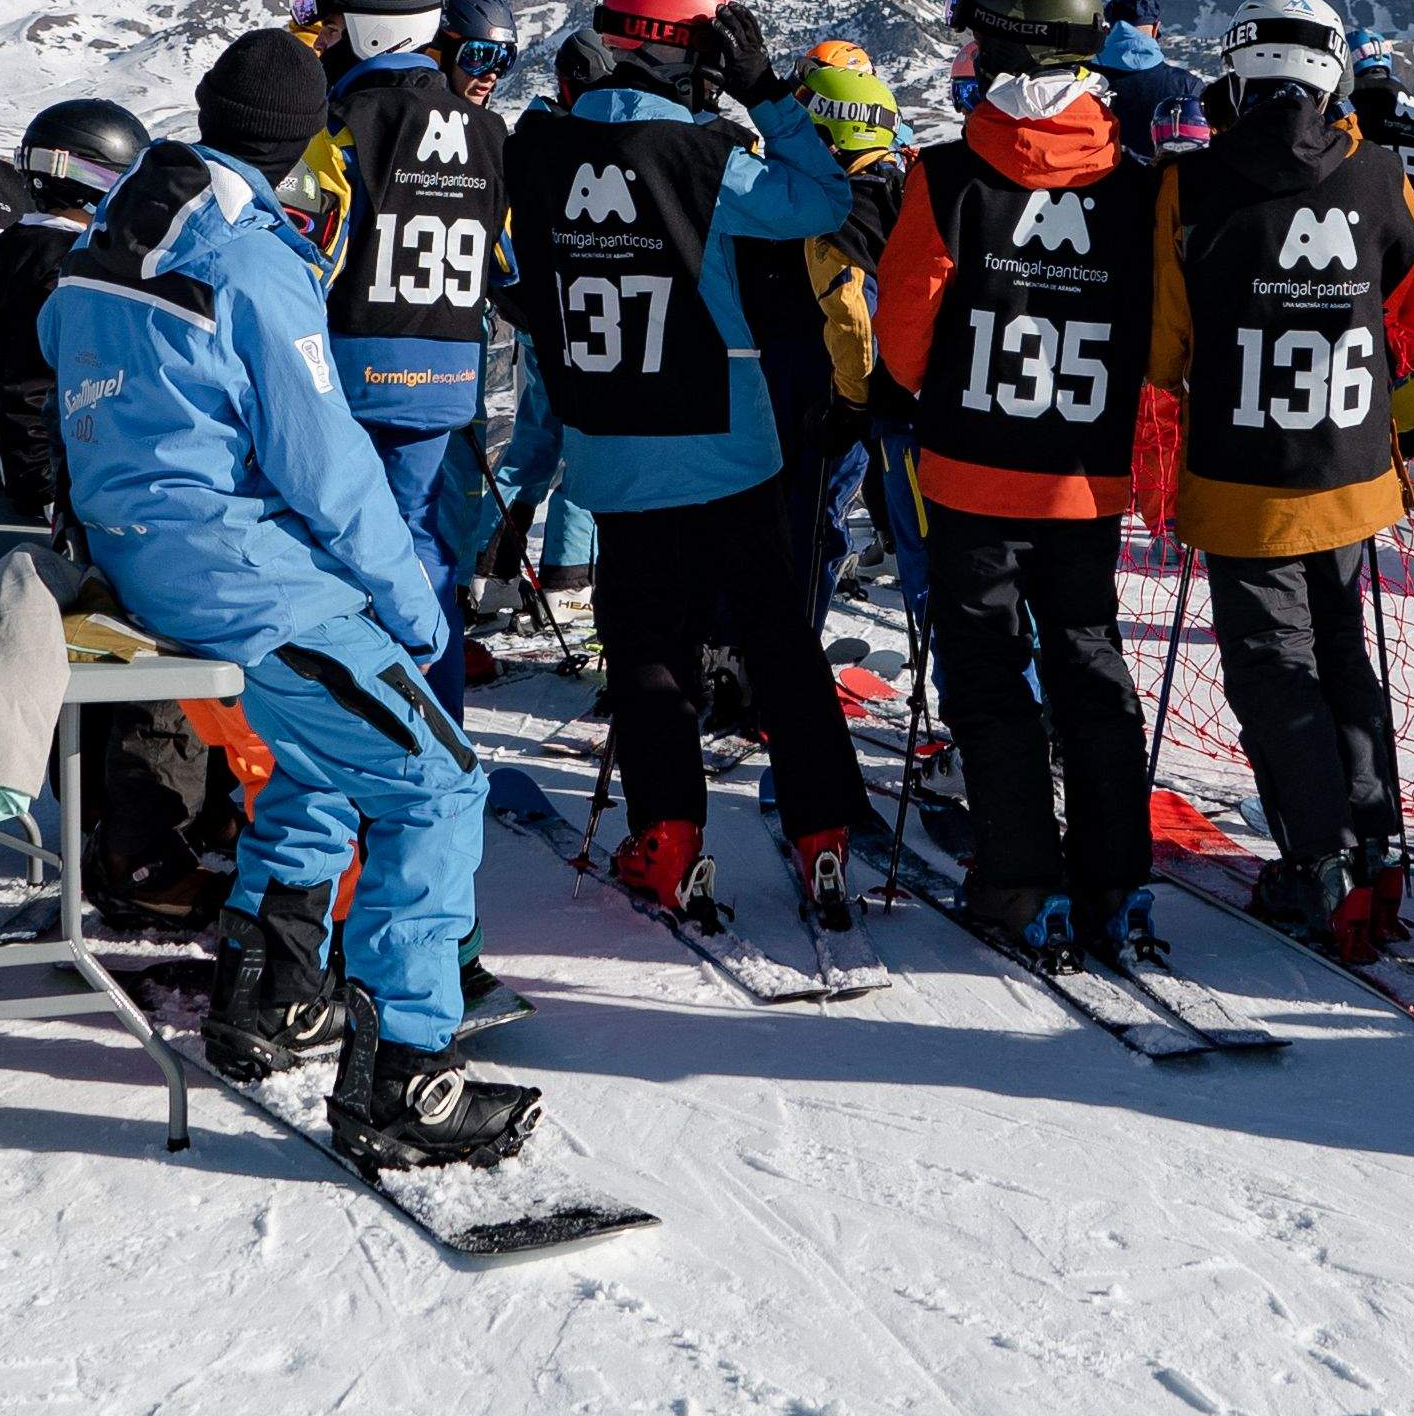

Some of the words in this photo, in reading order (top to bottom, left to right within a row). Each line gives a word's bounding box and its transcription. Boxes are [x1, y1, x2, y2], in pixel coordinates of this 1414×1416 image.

[623, 17, 690, 46] ULLER
[974, 7, 1049, 35] MARKER
[1222, 21, 1258, 51] LLER
[368, 213, 487, 307] 139
[984, 252, 1109, 283] formigal-panticosa
[961, 308, 1112, 423] 135
[1233, 326, 1374, 430] 136
[558, 600, 593, 612] HEA
